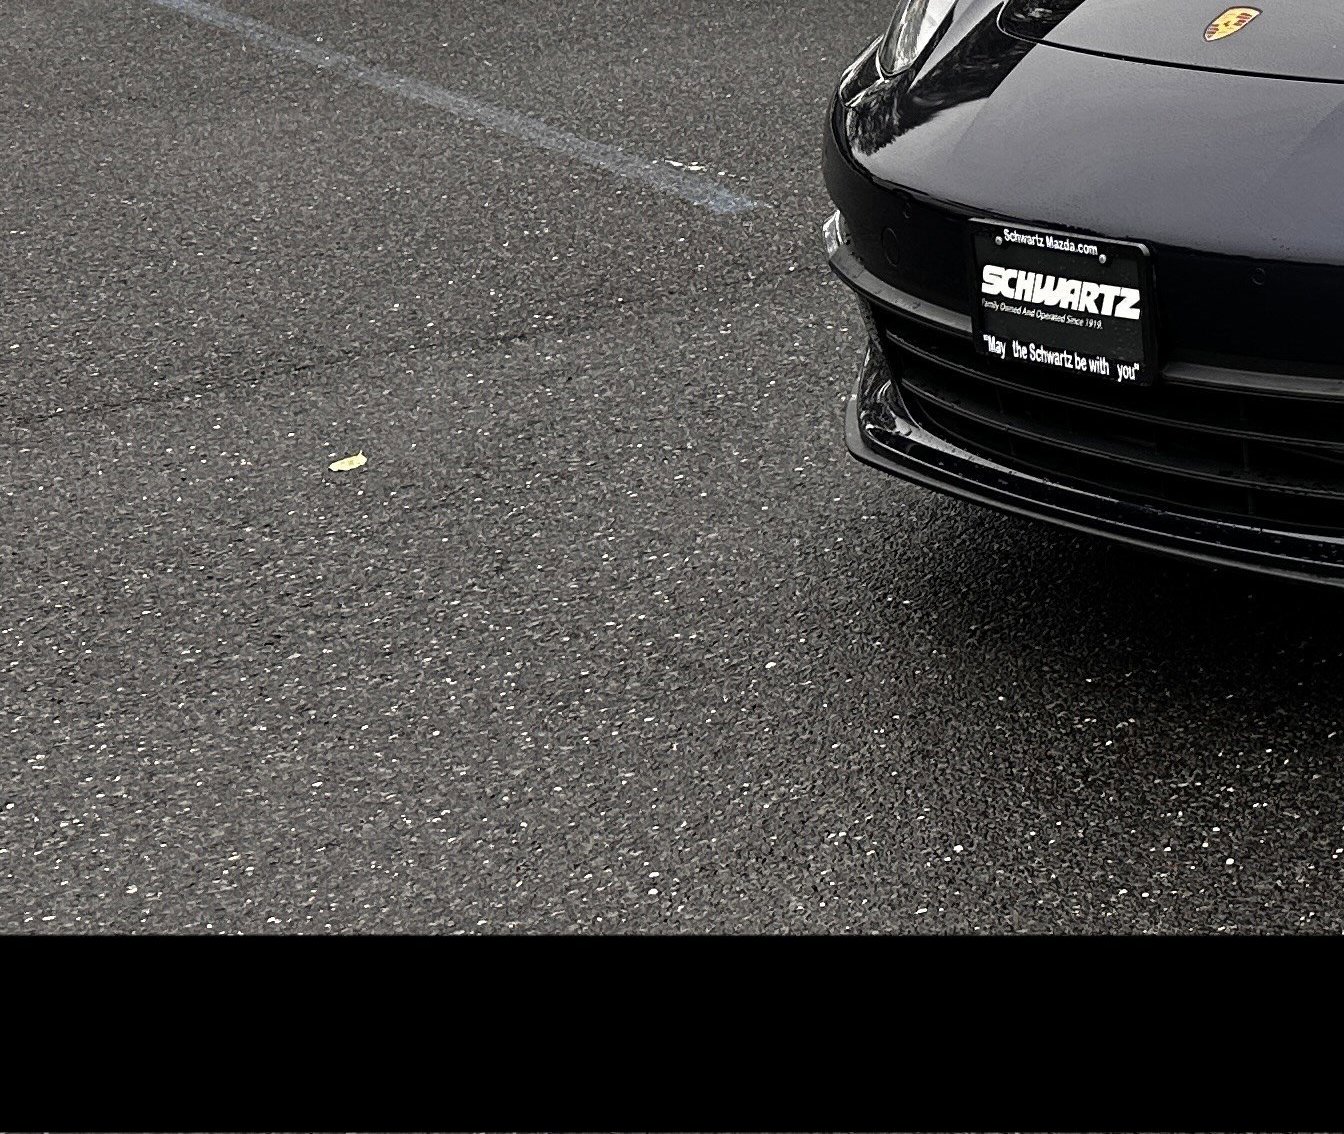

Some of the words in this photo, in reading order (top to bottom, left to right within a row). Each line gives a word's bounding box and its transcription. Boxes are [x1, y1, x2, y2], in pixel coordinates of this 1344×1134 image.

[1003, 228, 1045, 248] Schwartz
[1046, 236, 1098, 256] Mazda.com
[981, 264, 1141, 320] SCHWARTZ
[1000, 302, 1022, 315] Owned
[1022, 306, 1036, 318] And
[1036, 309, 1067, 324] Operated
[1066, 315, 1084, 327] Since
[983, 334, 1006, 360] "May
[1012, 340, 1028, 360] the
[1029, 343, 1074, 370] Schwartz
[1074, 351, 1087, 372] be
[1089, 356, 1110, 376] with
[1117, 362, 1140, 382] you"
